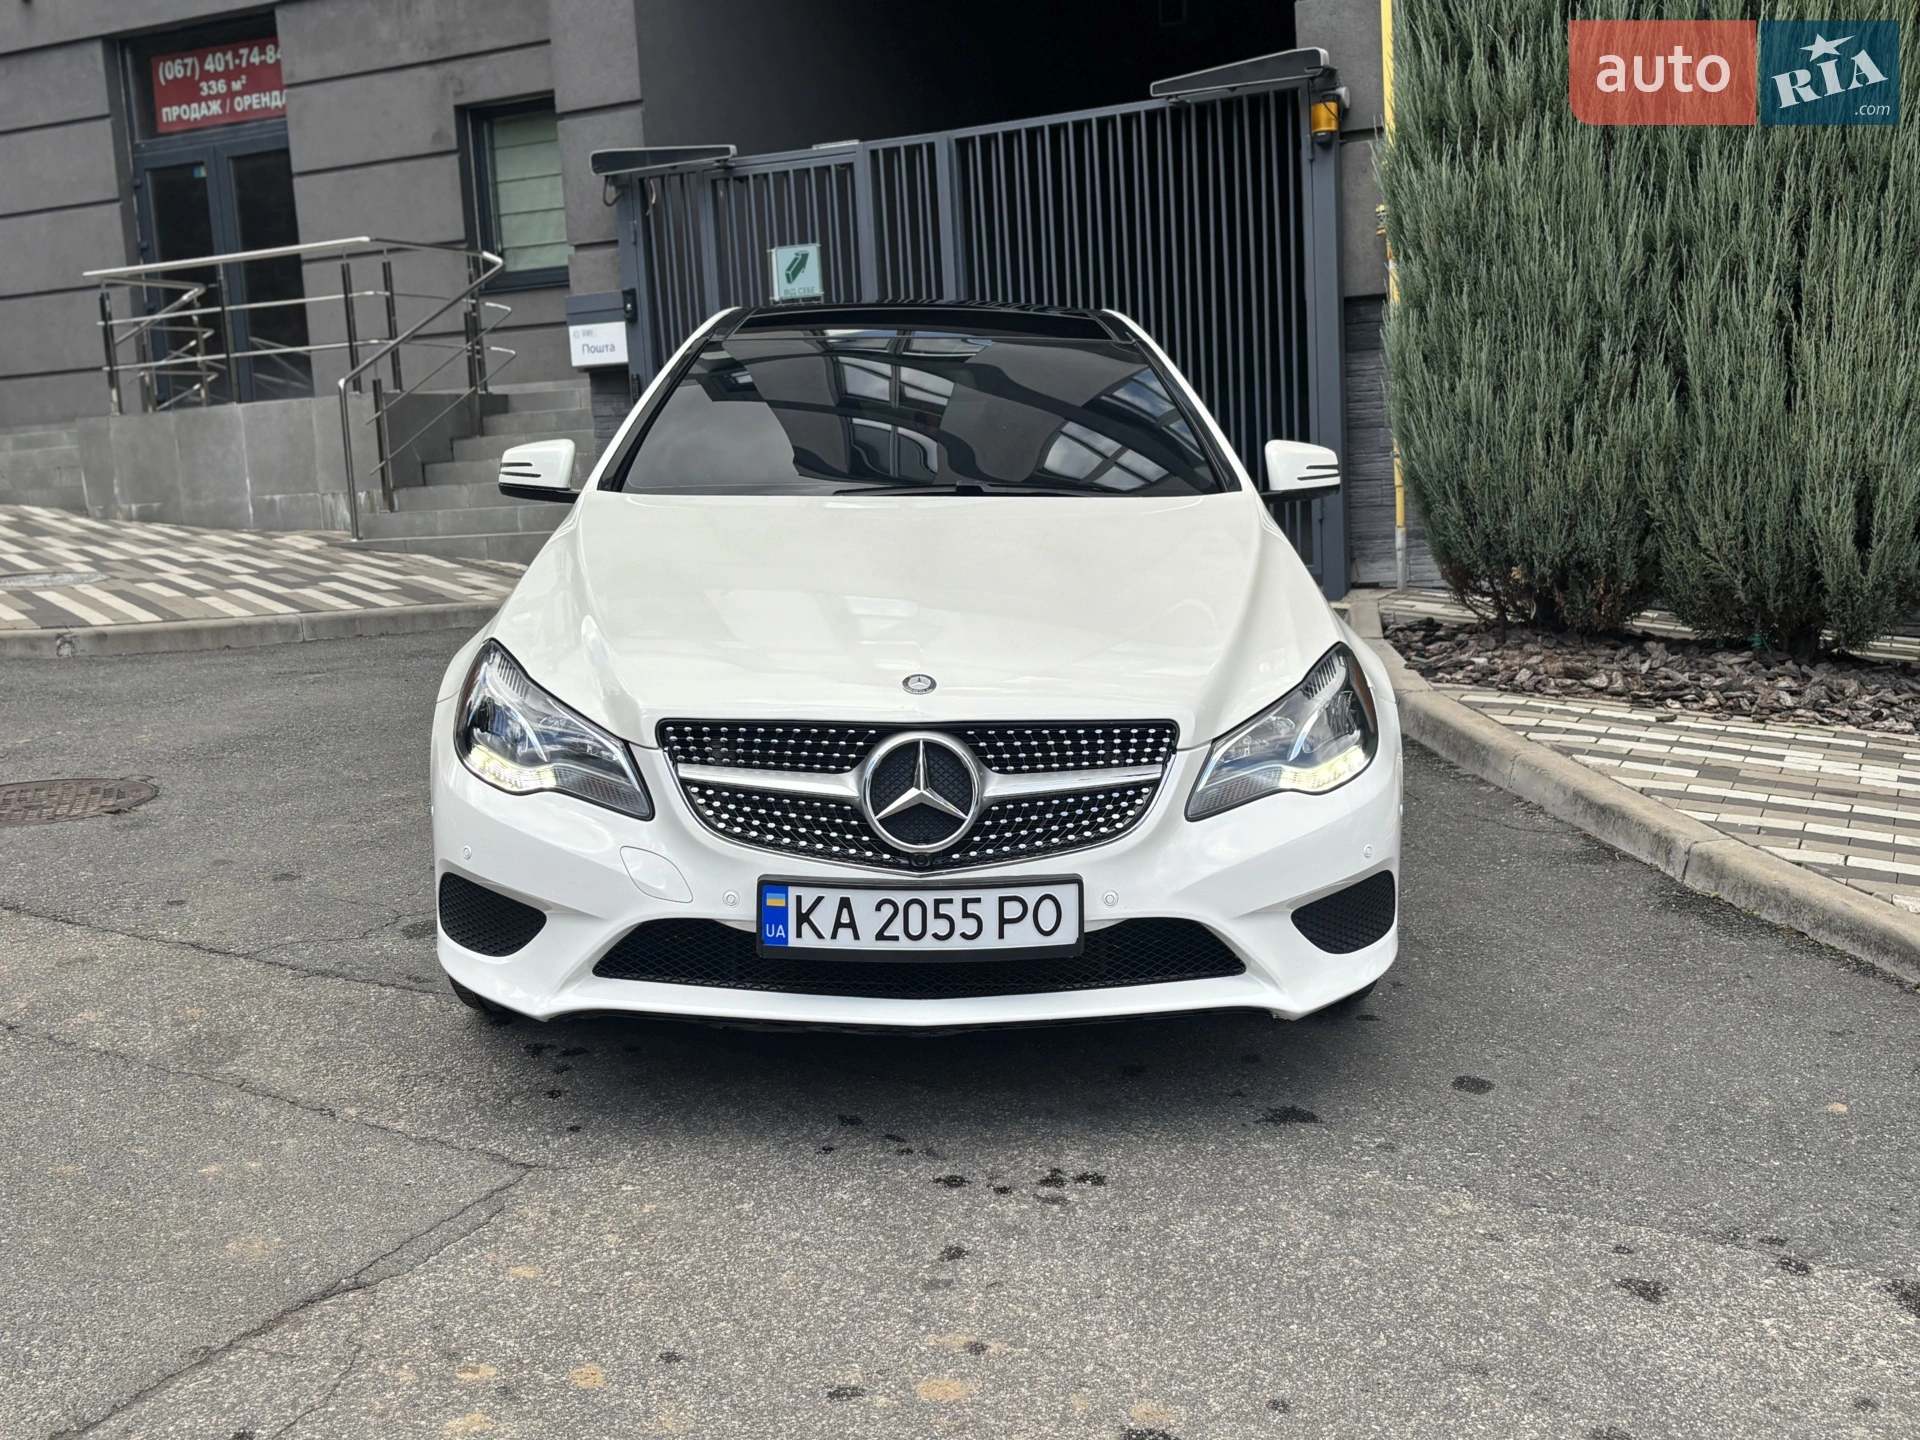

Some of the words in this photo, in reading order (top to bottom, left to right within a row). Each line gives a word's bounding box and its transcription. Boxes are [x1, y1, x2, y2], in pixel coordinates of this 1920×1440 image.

[158, 56, 200, 86] (067)
[199, 79, 227, 96] 336
[161, 98, 223, 123] ПРОДАЖ
[582, 343, 616, 355] Пошта
[795, 894, 861, 941] KA
[874, 897, 984, 942] 2055
[997, 893, 1063, 940] PO
[765, 923, 787, 938] UA
